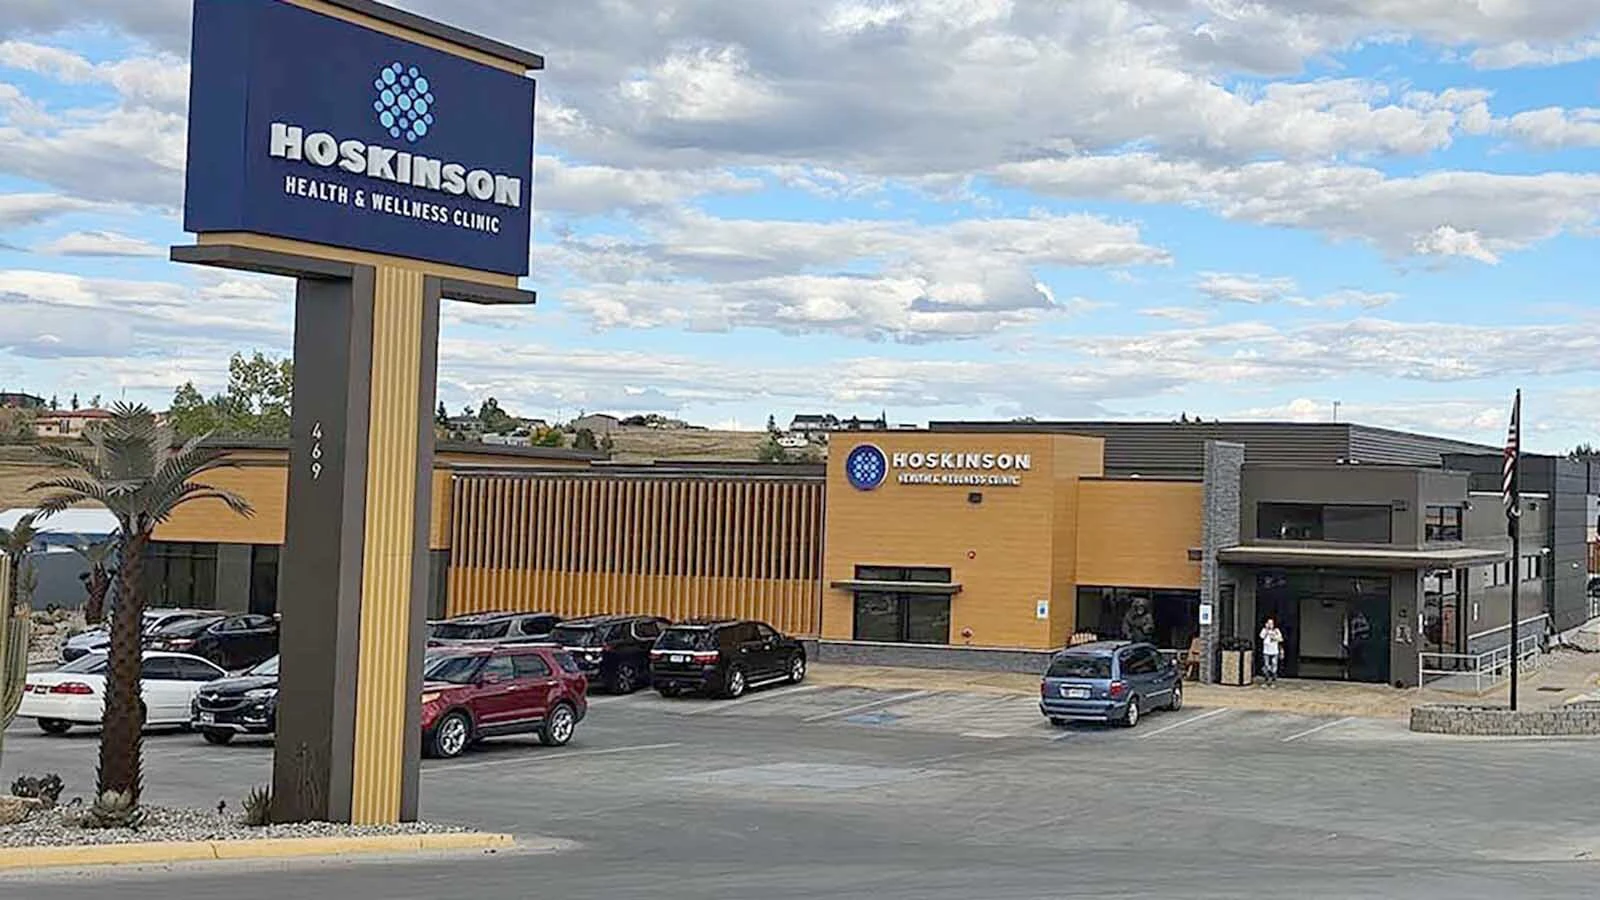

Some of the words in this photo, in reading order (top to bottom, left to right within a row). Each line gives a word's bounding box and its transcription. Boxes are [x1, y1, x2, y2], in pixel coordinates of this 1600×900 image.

[270, 122, 521, 207] HOSKINSON
[286, 176, 348, 204] HEALTH
[354, 190, 366, 207] &
[371, 192, 449, 223] WELLNESS
[453, 211, 500, 233] CLINIC
[312, 422, 322, 479] 469
[893, 453, 1031, 469] HOSKINSON
